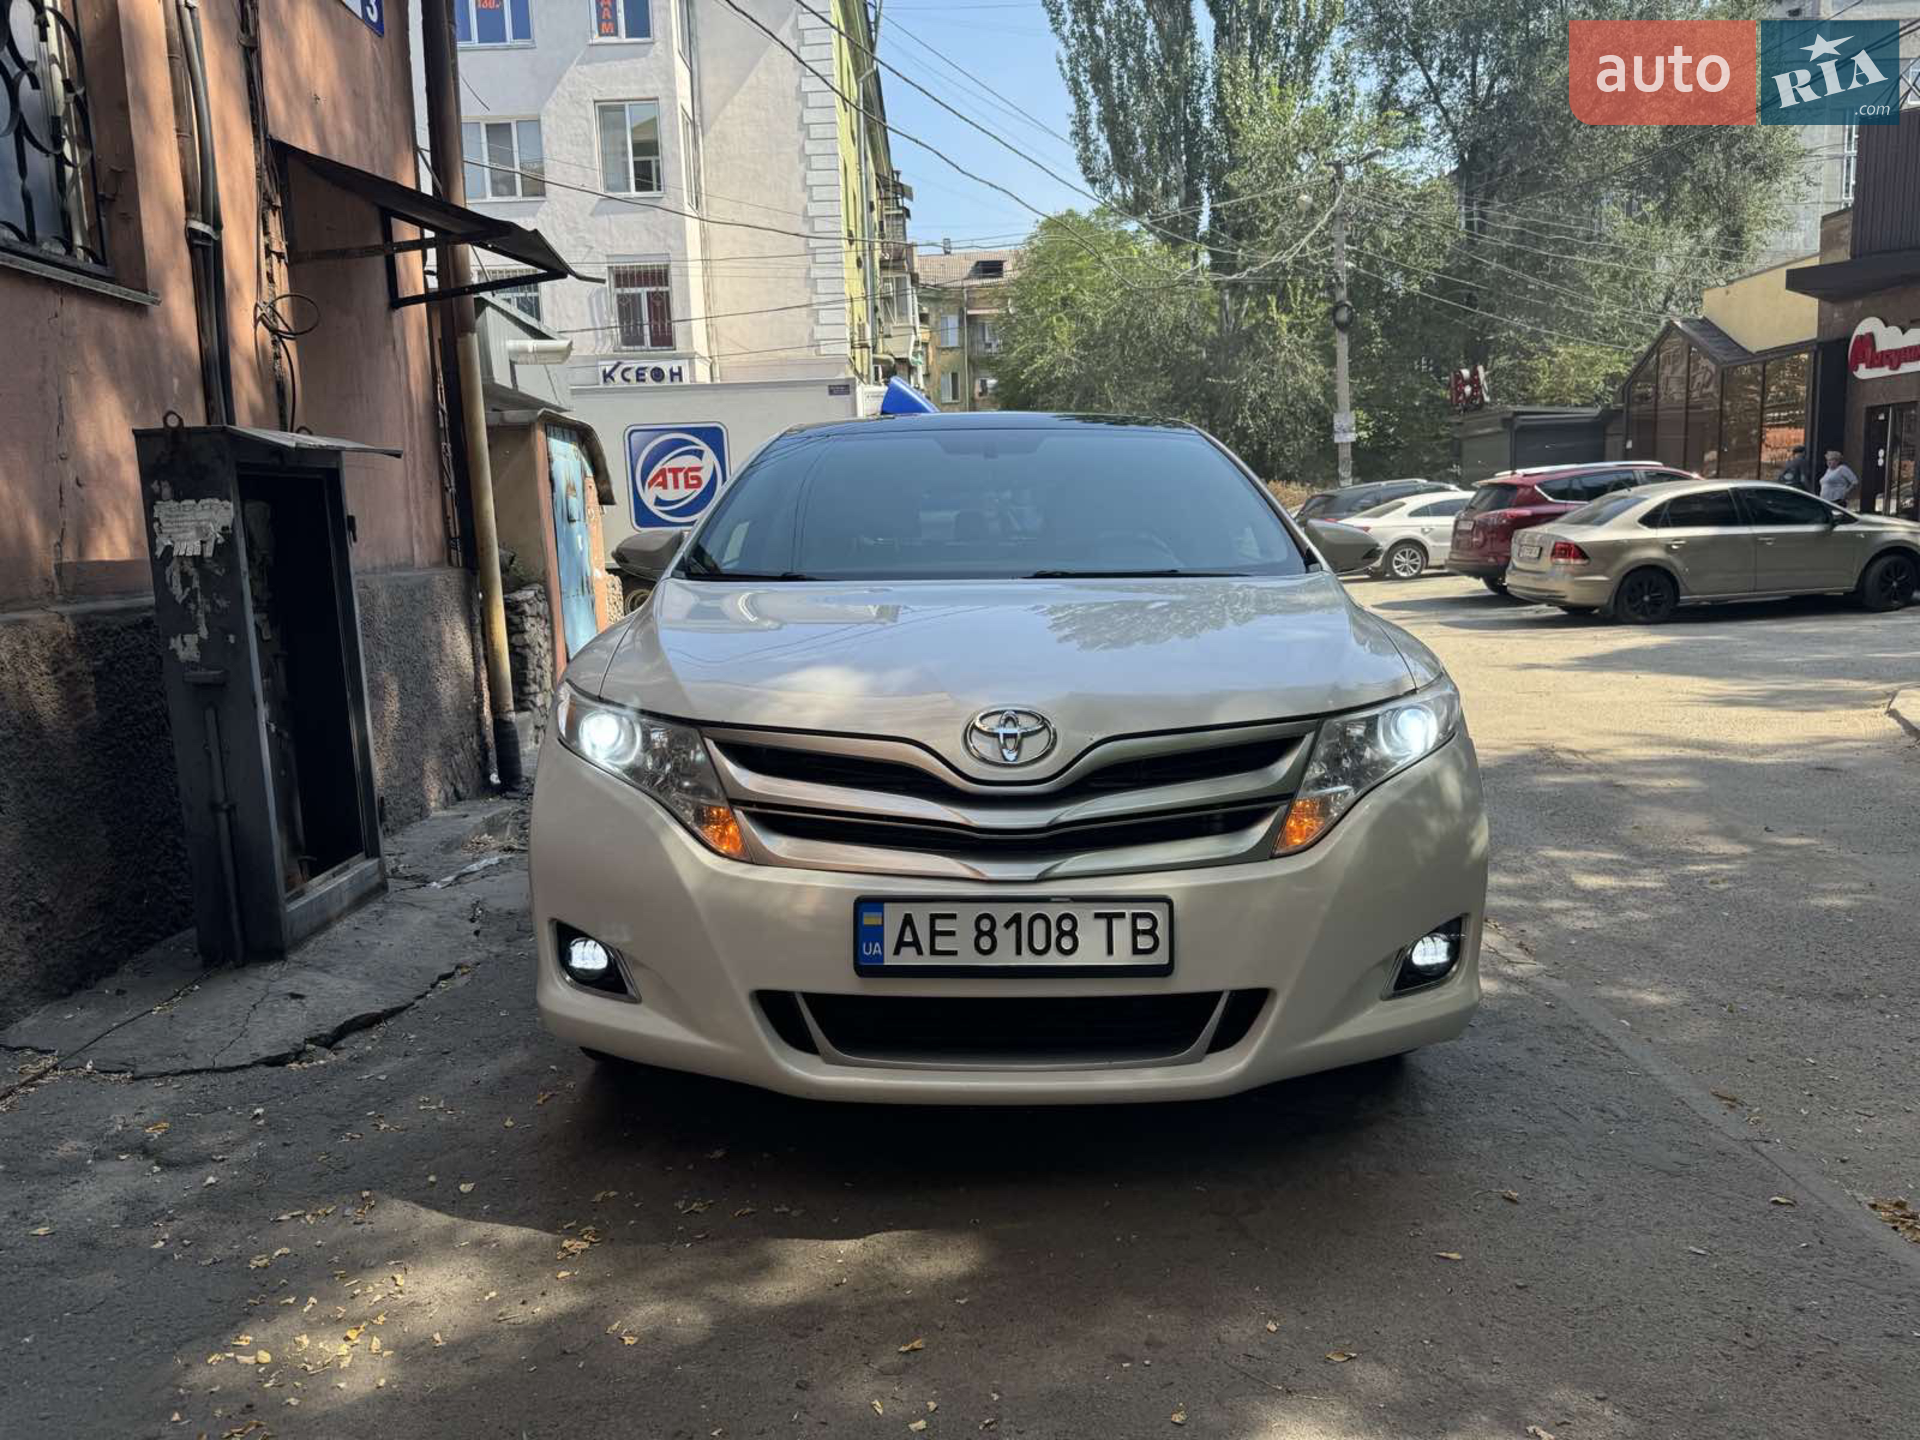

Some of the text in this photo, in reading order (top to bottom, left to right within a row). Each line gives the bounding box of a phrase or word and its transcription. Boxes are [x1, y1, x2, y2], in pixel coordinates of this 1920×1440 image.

[648, 466, 704, 490] АТБ
[892, 911, 1160, 956] AE 8108 TB
[862, 941, 882, 955] UA
